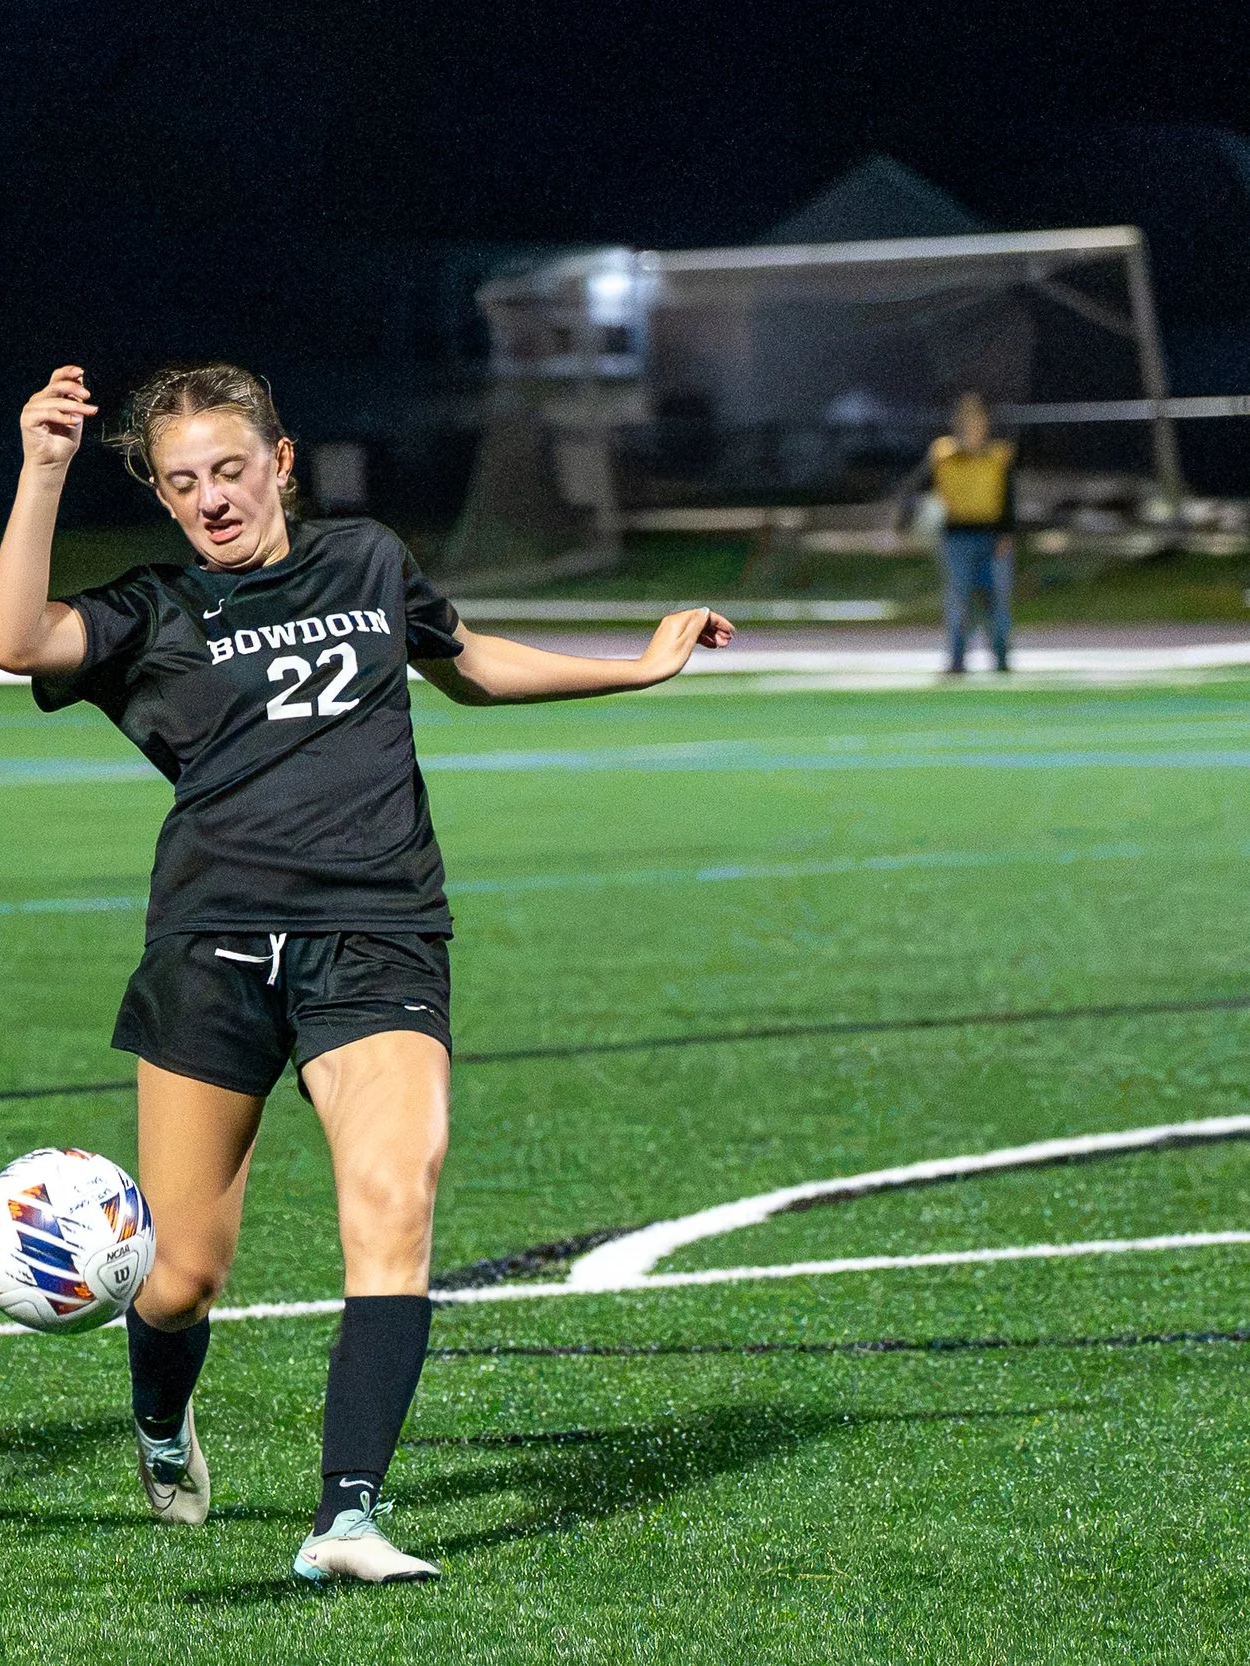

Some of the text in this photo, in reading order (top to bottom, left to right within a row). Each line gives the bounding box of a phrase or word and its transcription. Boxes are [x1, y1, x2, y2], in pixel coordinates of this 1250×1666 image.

[206, 608, 391, 666] BOWDOIN
[266, 641, 361, 721] 22
[106, 1244, 131, 1262] NCAA
